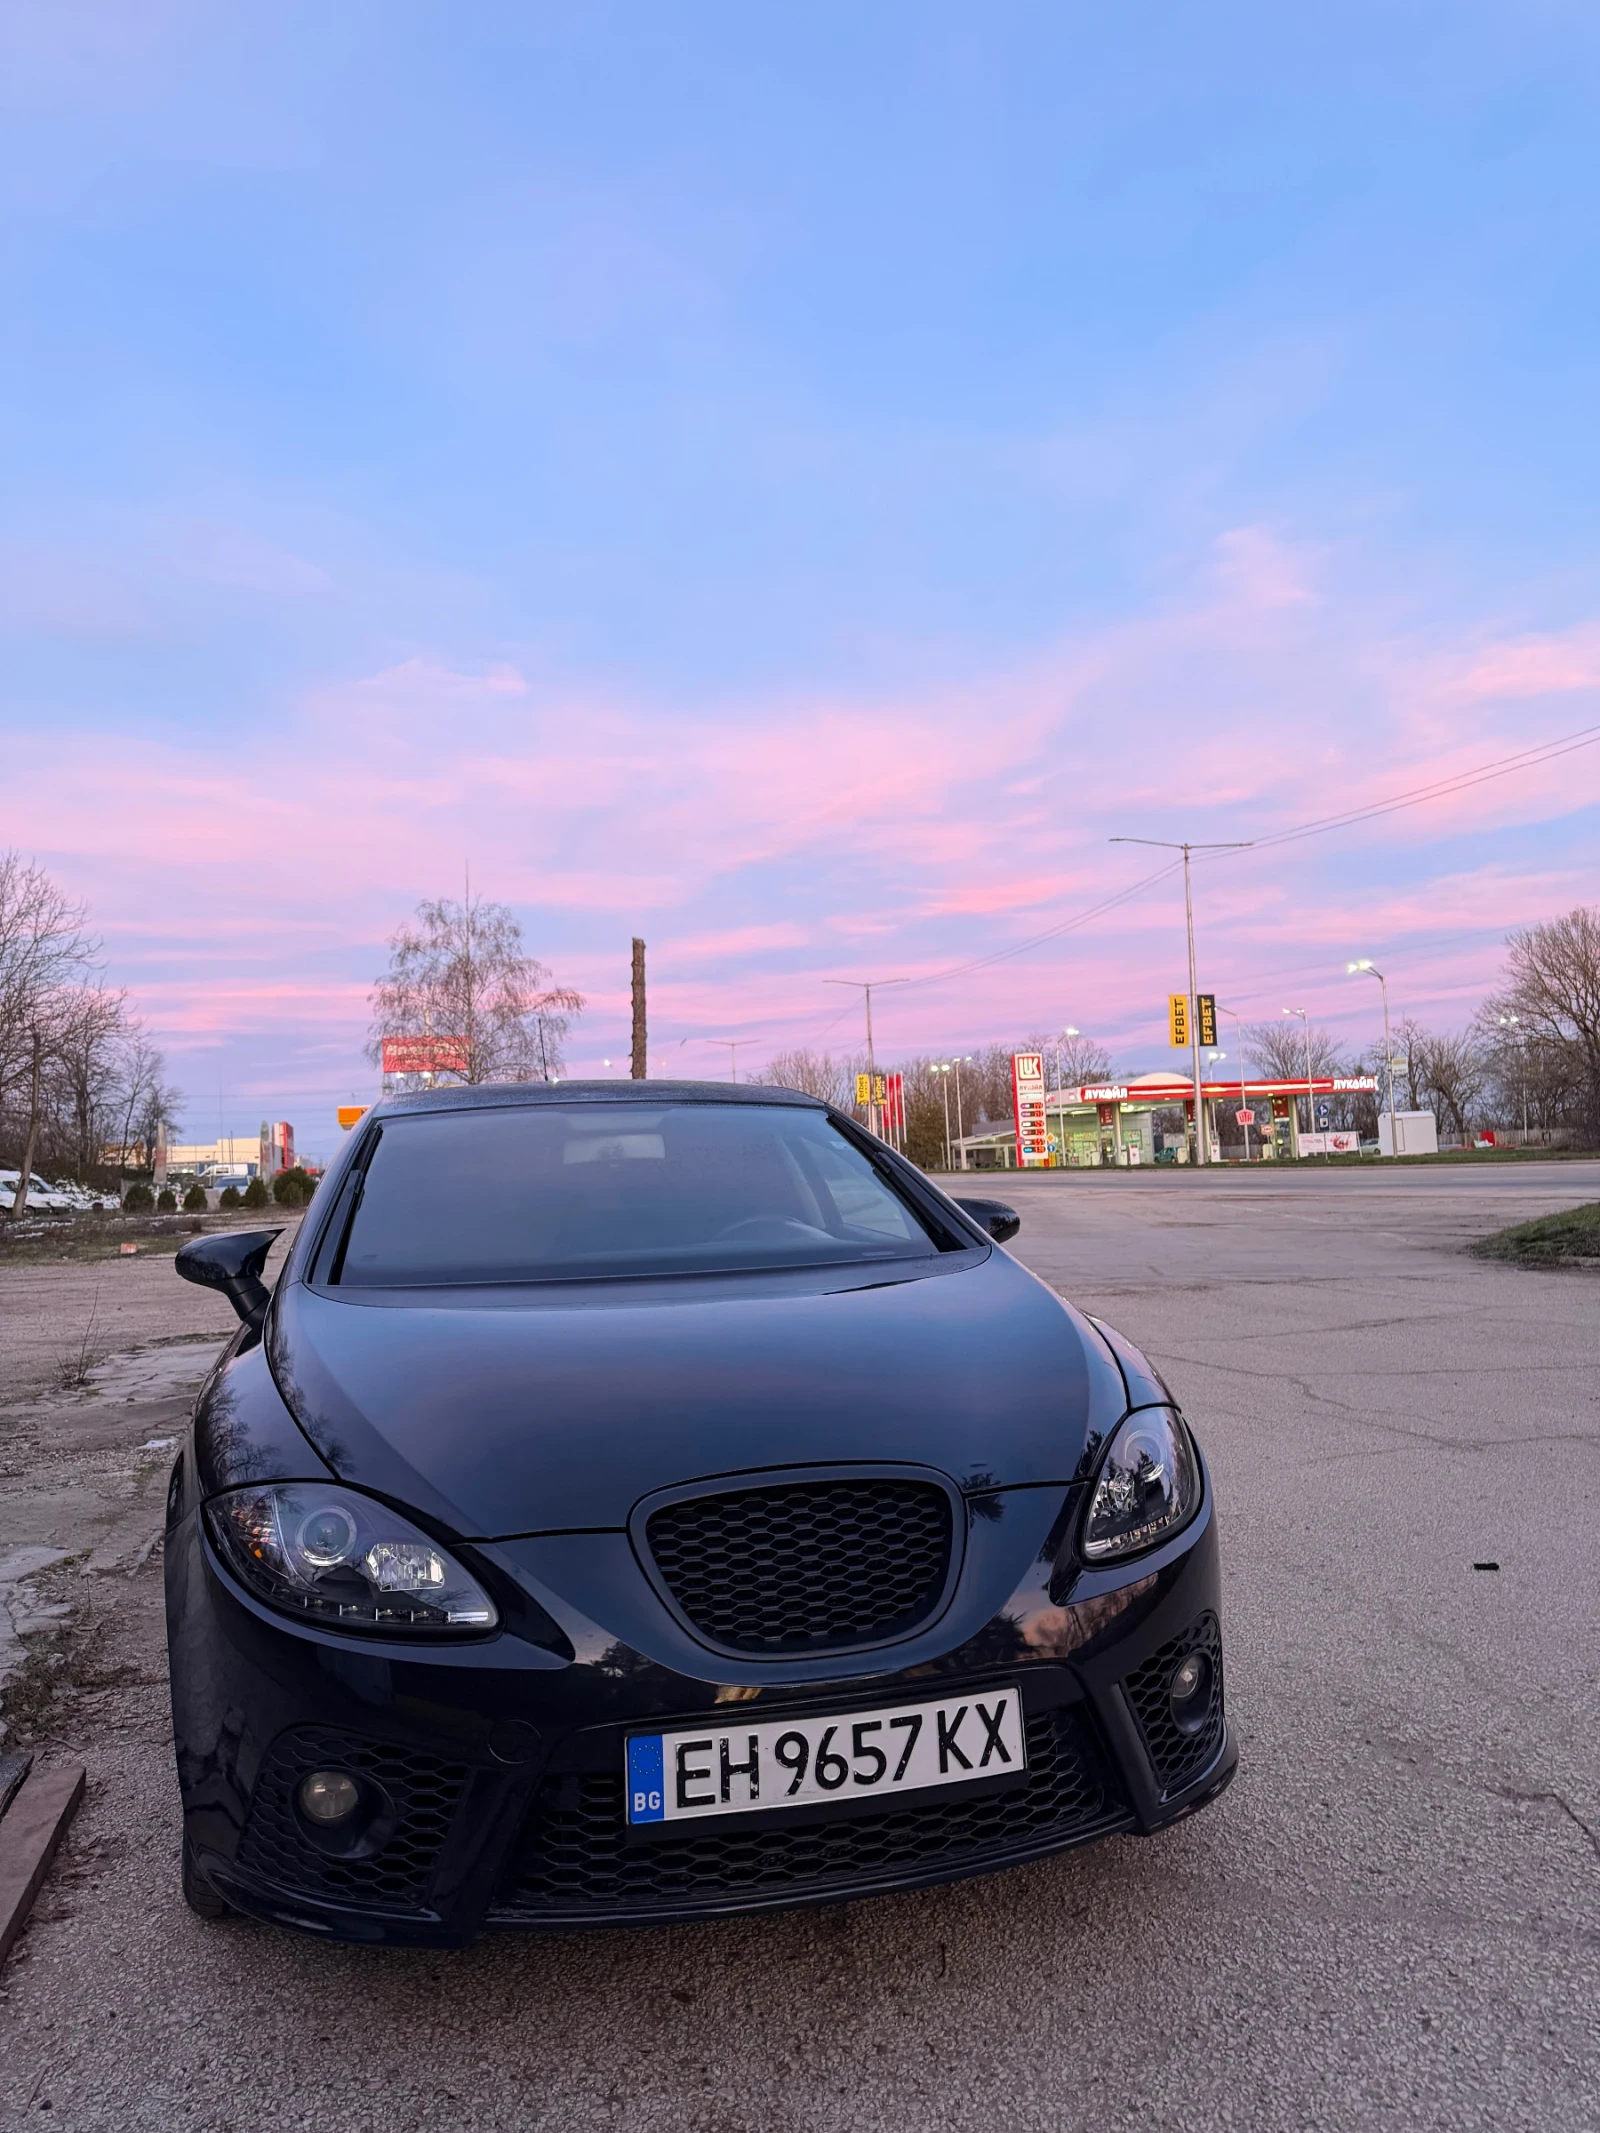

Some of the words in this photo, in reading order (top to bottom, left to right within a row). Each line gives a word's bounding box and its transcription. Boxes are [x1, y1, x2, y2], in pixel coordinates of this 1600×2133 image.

[1174, 999, 1184, 1044] EFBET
[1201, 998, 1213, 1044] EFBET
[1084, 1085, 1128, 1100] ЛУКОЙЛ
[1333, 1076, 1374, 1090] ЛУКОЙЛ
[675, 1735, 760, 1808] EH
[774, 1713, 923, 1797] 9657
[937, 1699, 1012, 1774] KX
[633, 1791, 661, 1812] BG
